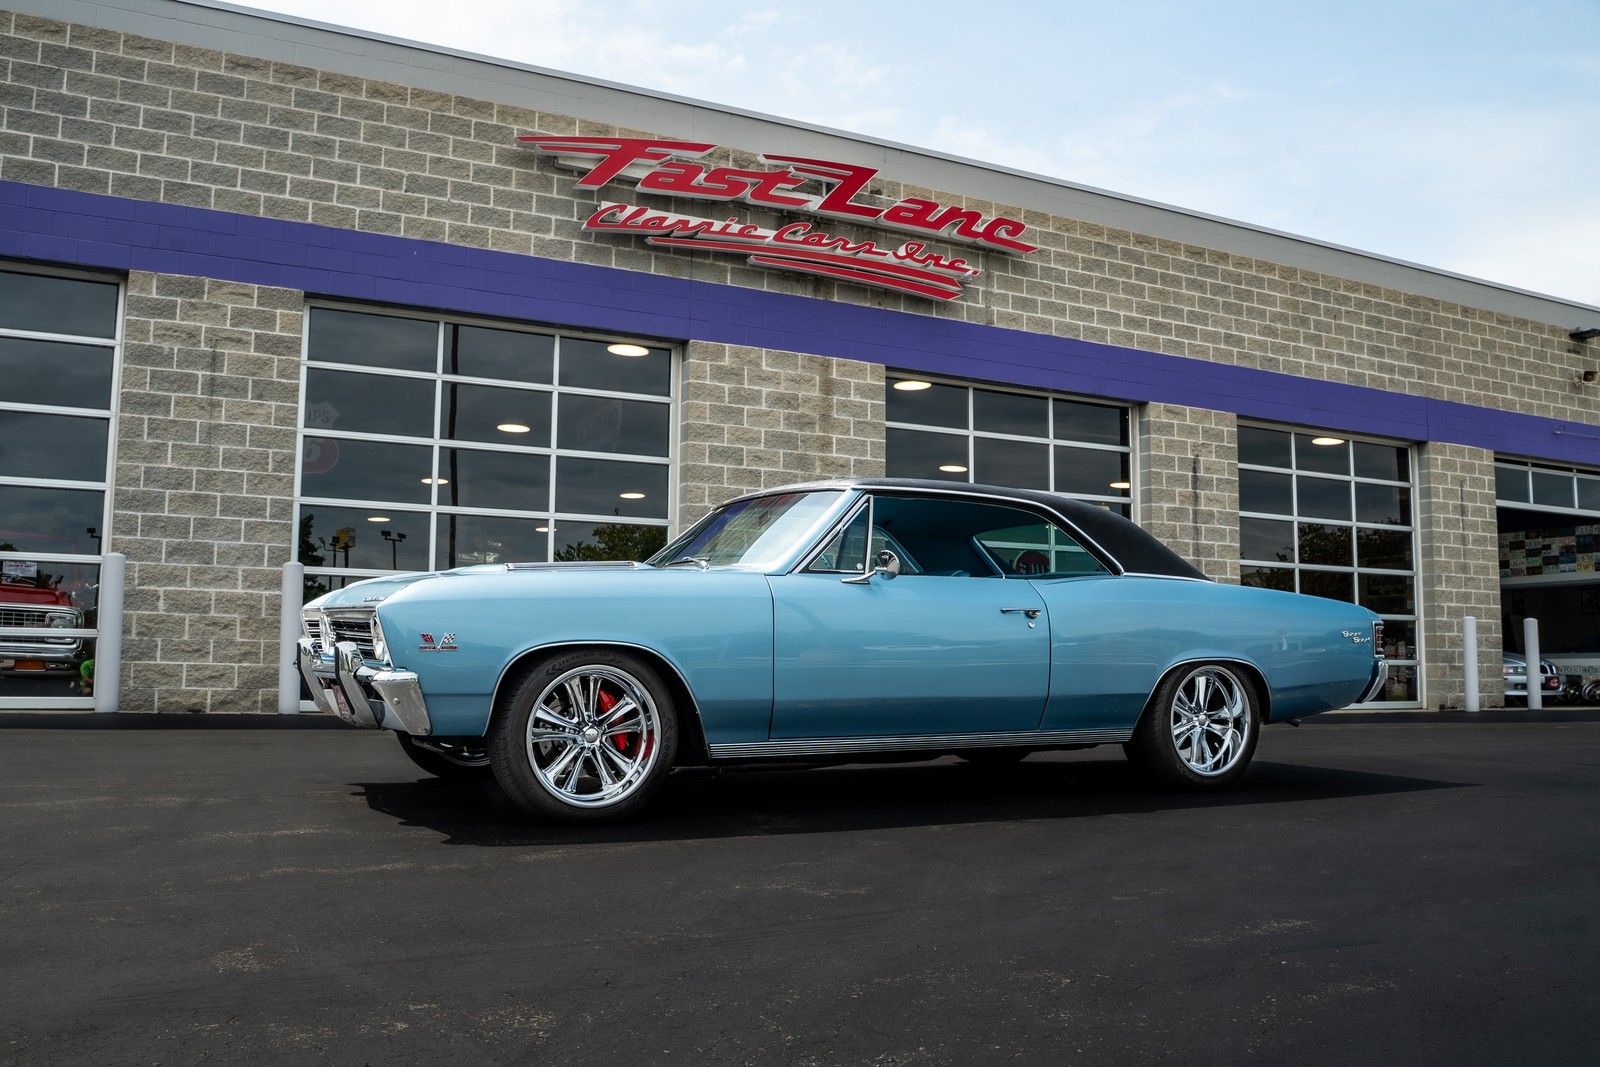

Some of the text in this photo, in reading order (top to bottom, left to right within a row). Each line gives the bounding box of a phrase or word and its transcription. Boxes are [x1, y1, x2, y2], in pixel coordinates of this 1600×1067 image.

[515, 135, 1039, 254] Fast Lane
[584, 203, 772, 241] Classic
[772, 222, 890, 257] Cars
